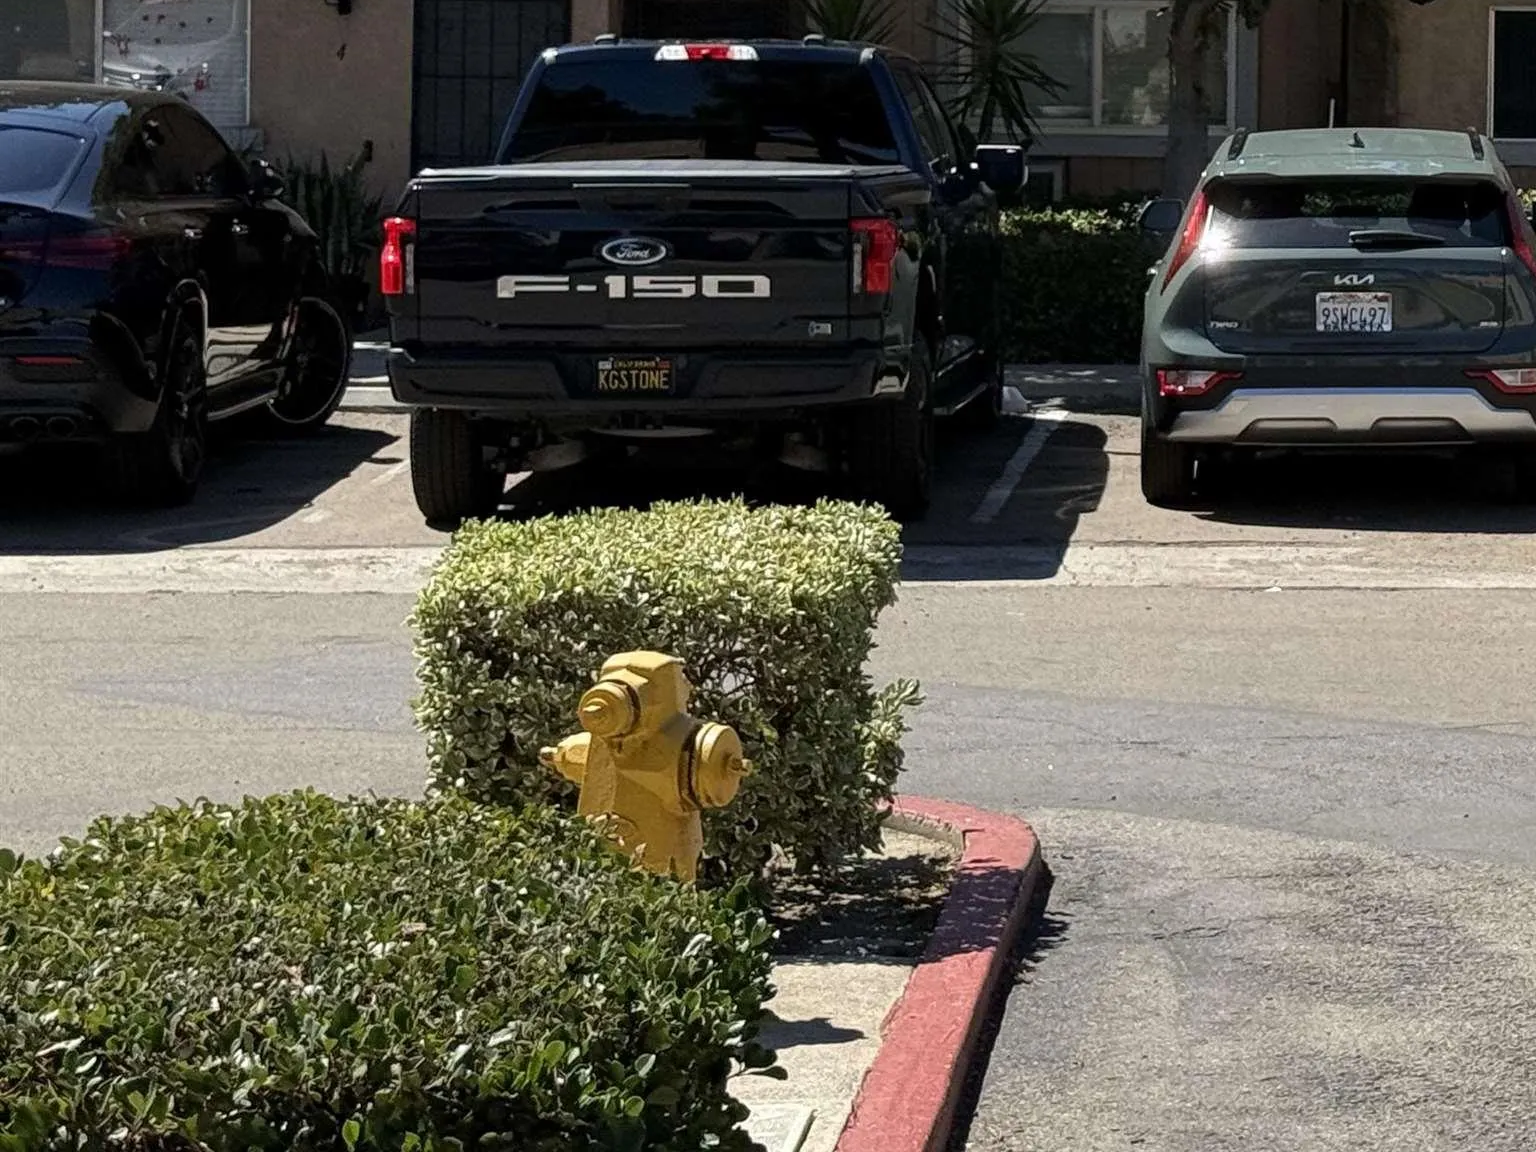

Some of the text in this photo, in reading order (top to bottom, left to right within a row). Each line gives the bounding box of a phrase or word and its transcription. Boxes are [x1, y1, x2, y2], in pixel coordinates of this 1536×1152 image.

[616, 244, 650, 259] Ford
[497, 275, 771, 298] F-150
[1333, 274, 1375, 286] KIA
[598, 369, 670, 390] KGSTONE
